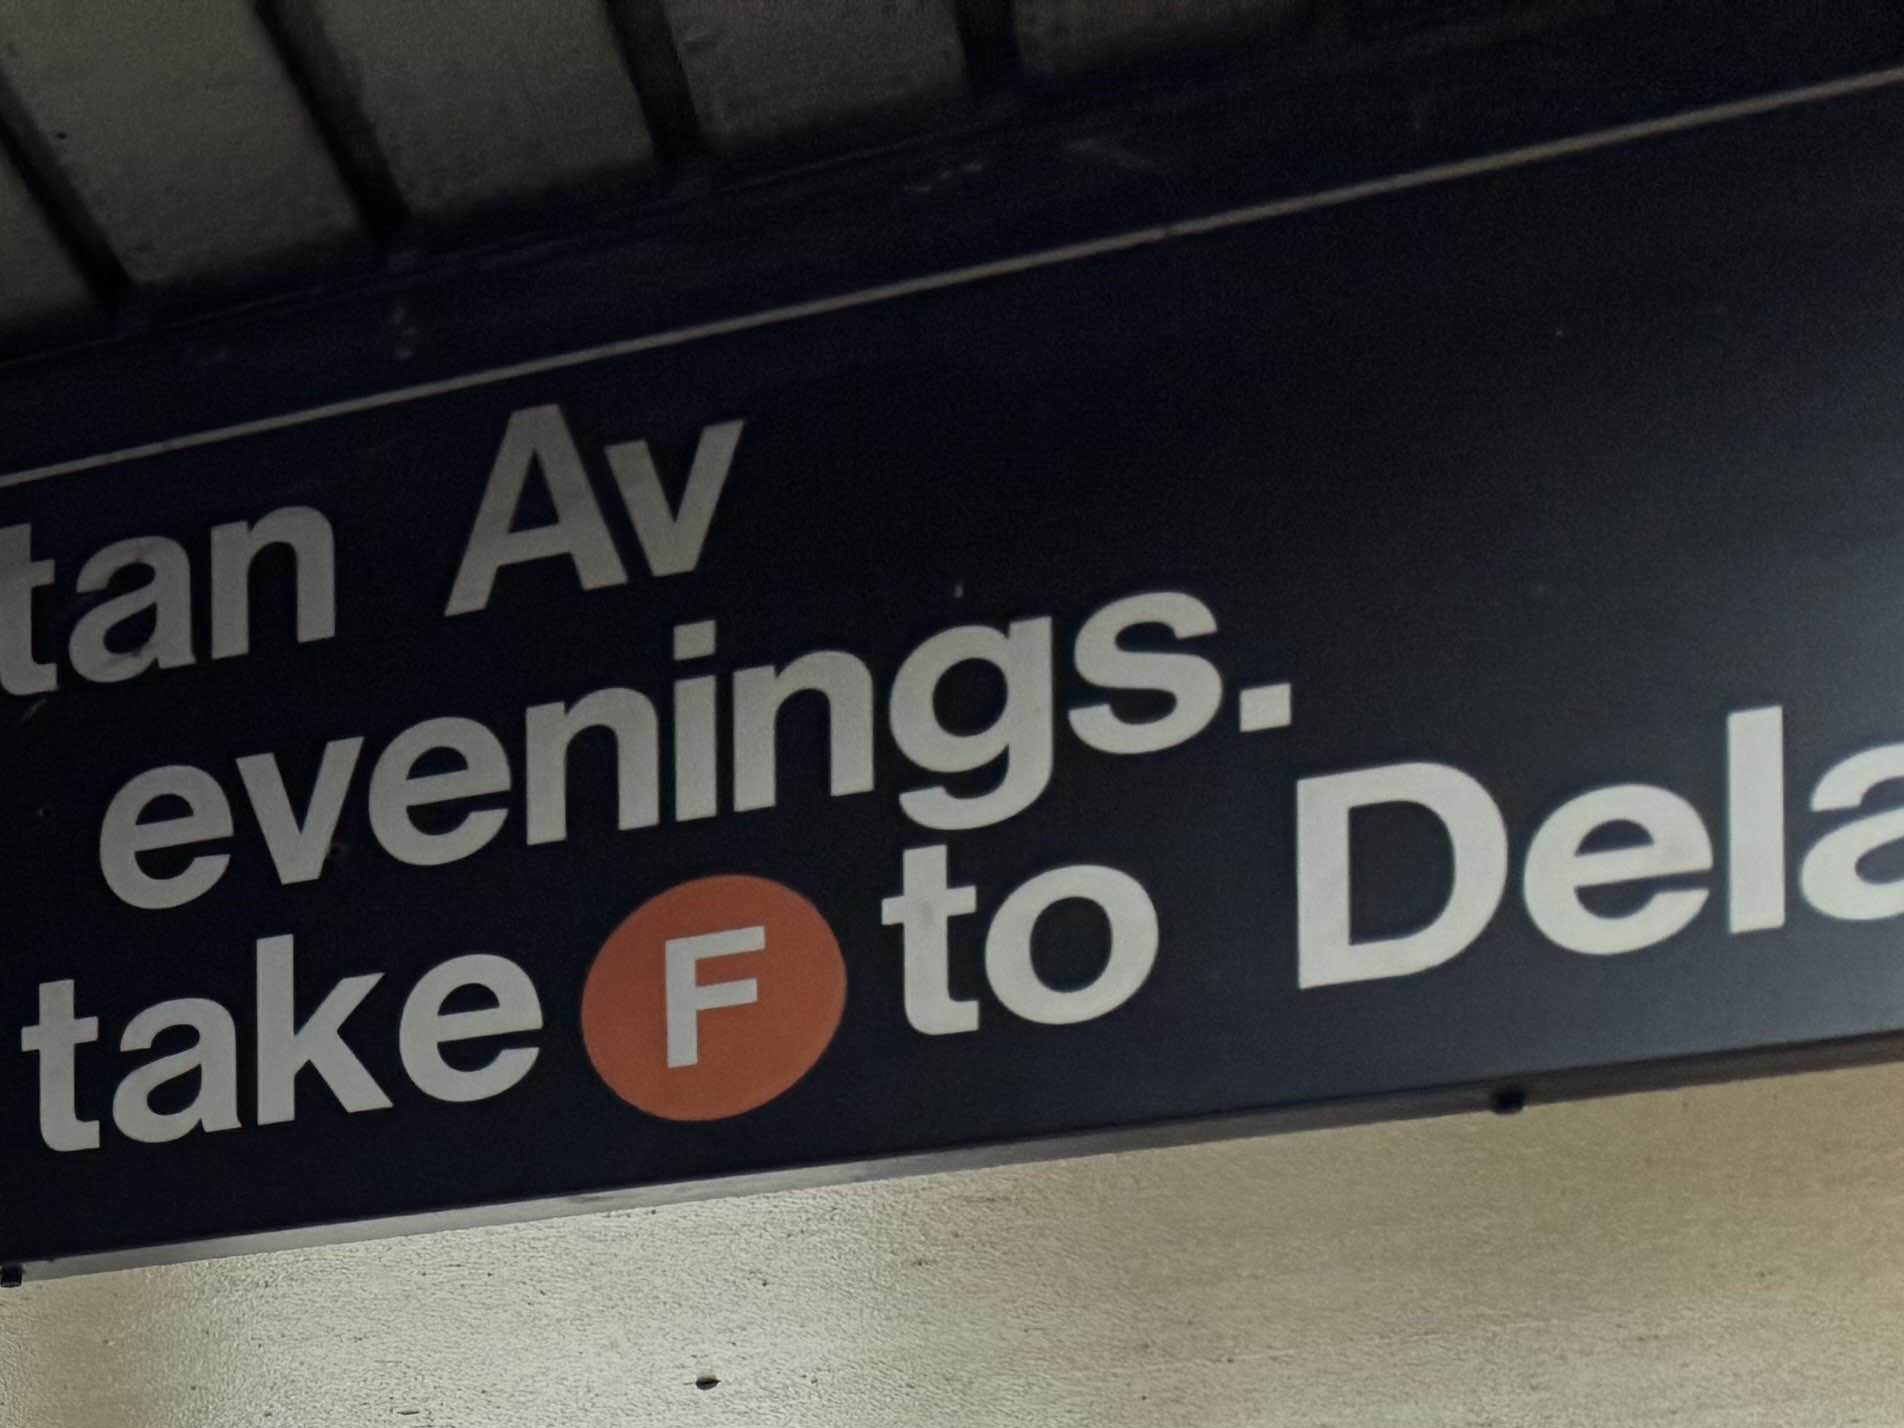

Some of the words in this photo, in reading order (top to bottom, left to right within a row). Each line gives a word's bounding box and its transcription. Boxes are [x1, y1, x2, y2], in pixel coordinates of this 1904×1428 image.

[445, 404, 744, 617] Av
[99, 591, 1292, 910] evenings.
[21, 934, 543, 1152] take
[665, 926, 765, 1068] F
[881, 844, 1159, 1036] to
